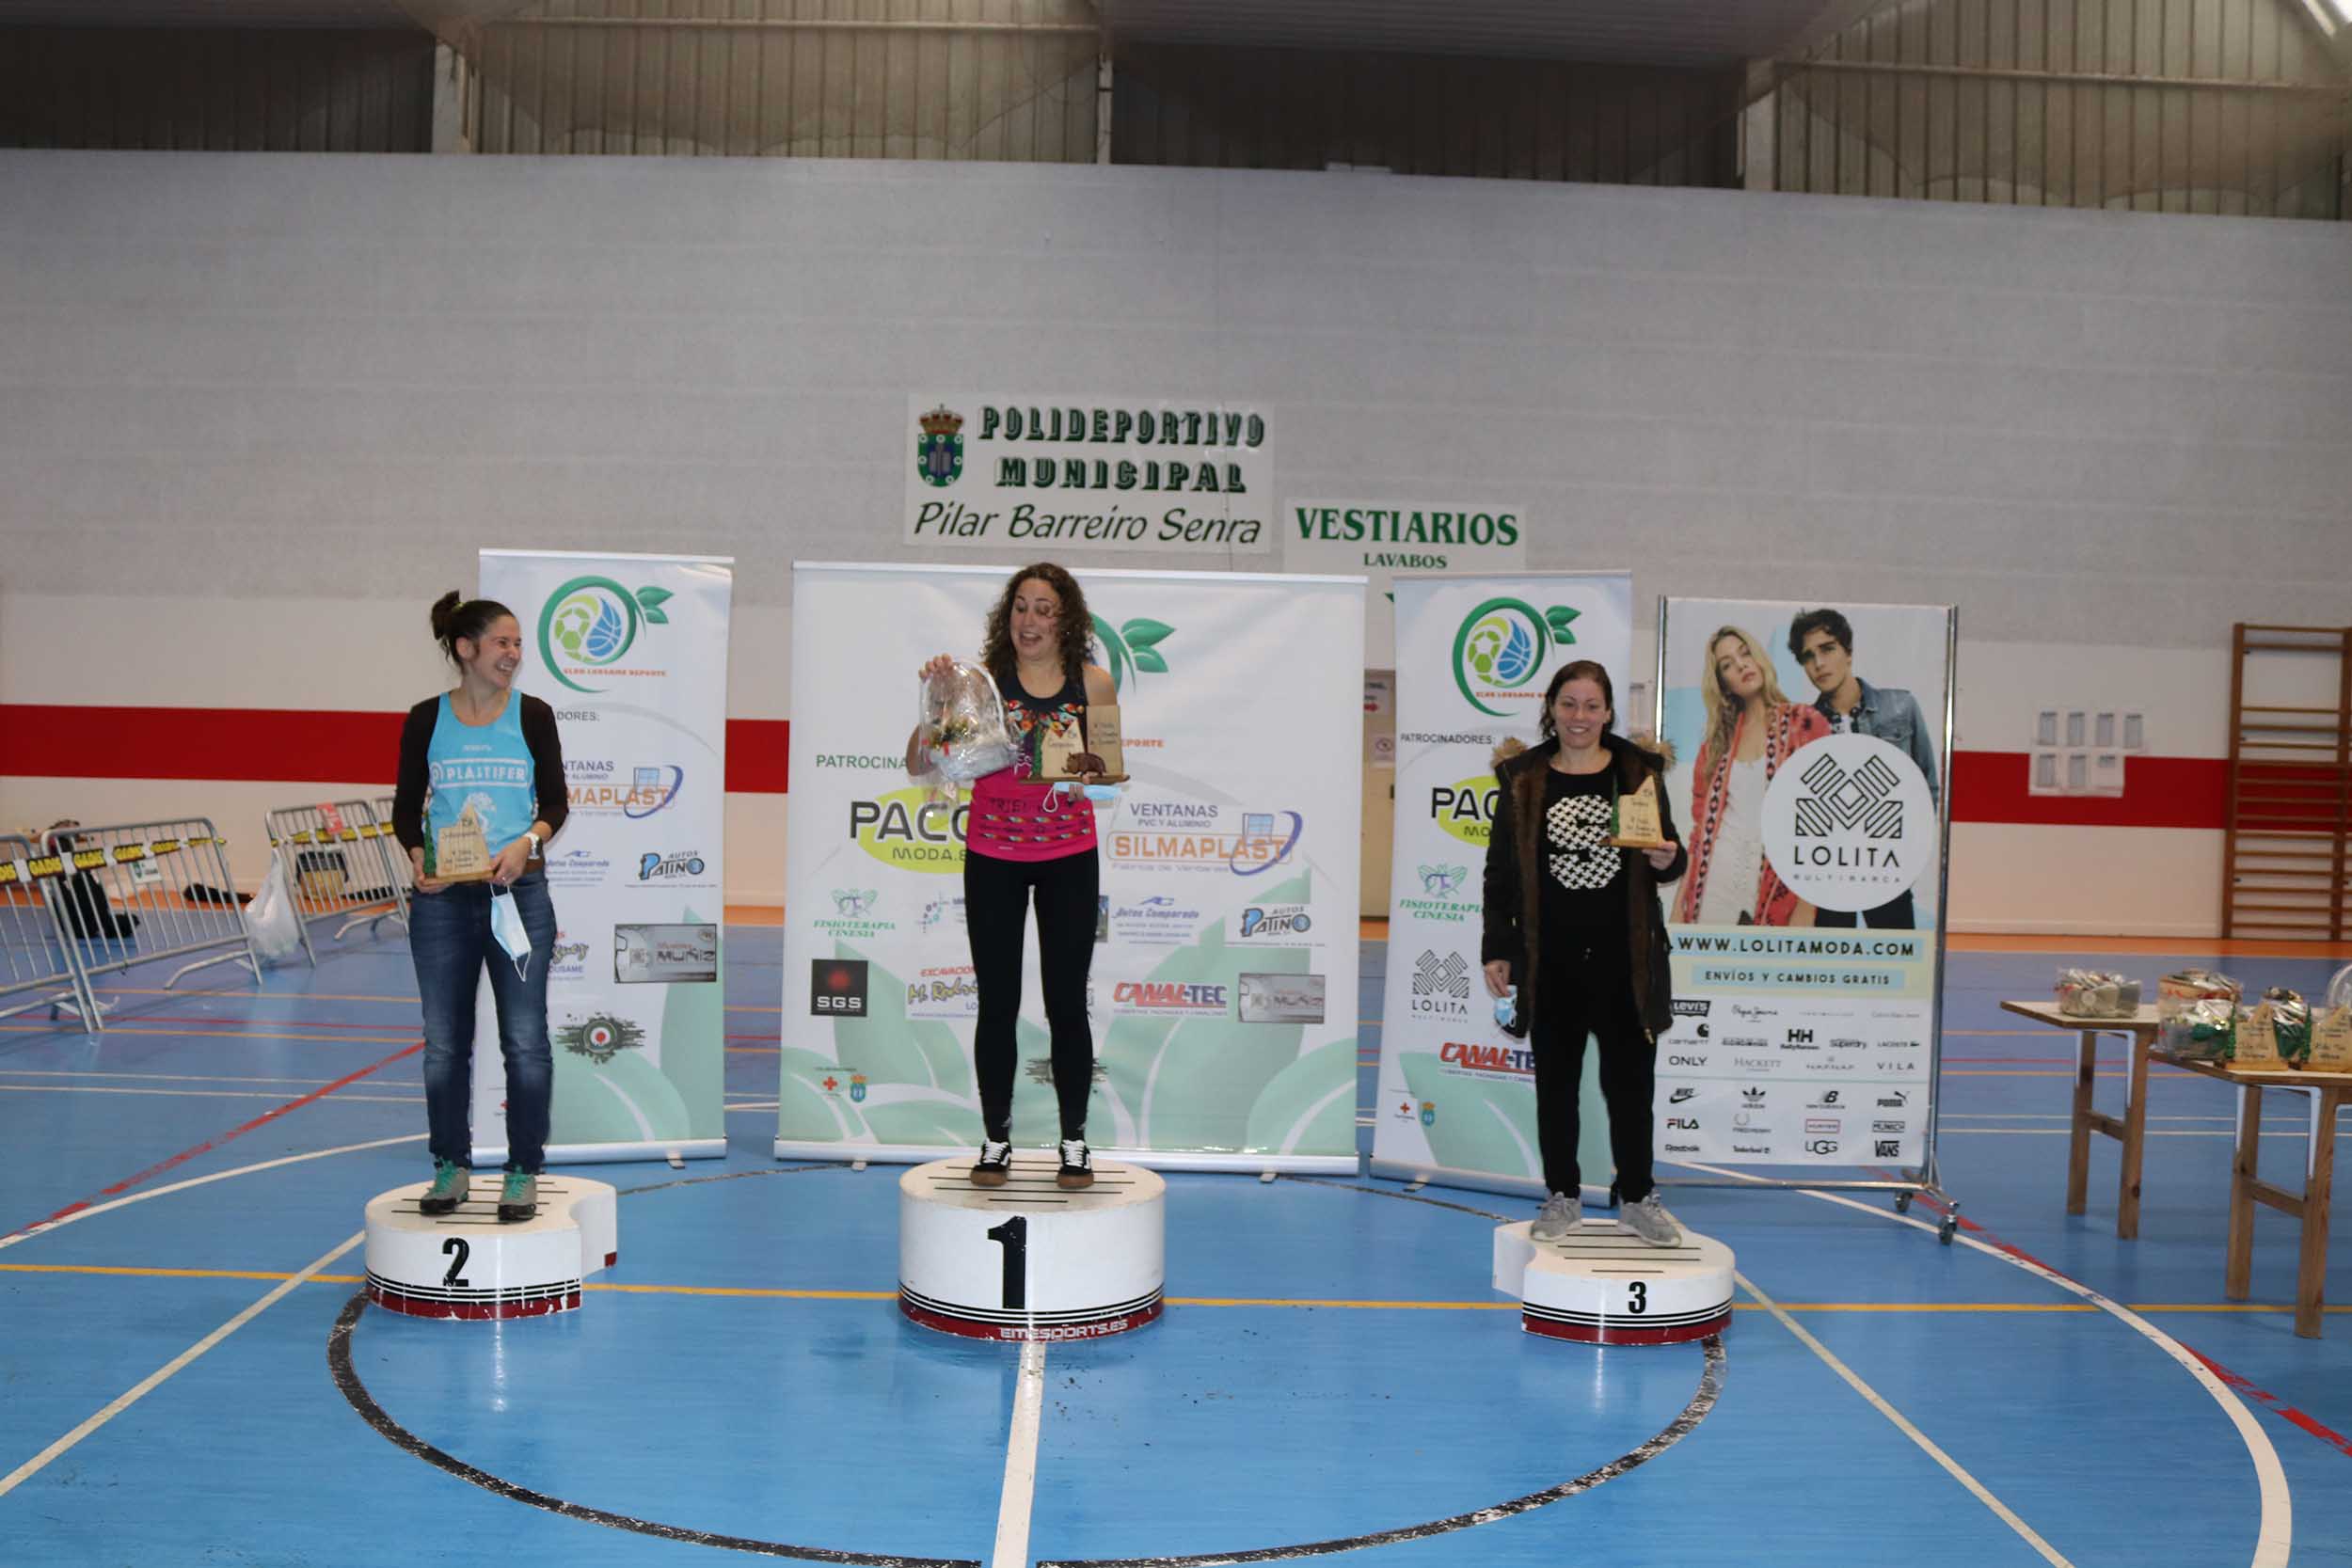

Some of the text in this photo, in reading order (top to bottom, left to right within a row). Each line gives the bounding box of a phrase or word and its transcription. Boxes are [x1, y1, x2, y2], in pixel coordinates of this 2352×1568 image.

[978, 405, 1265, 448] POLIDEPORTIVO
[995, 456, 1248, 493] MUNICIPAL
[914, 501, 1261, 544] Pilar Barreiro Senra
[1295, 507, 1518, 546] VESTIARIOS
[1363, 553, 1447, 570] LAVABOS
[1130, 803, 1219, 818] VENTANAS
[1137, 818, 1156, 828] PVC
[1158, 819, 1165, 828] Y
[1114, 835, 1288, 860] SILMAPLAST
[1793, 846, 1900, 868] LOLITA
[1677, 936, 1915, 957] WWW.LOLITAMODA.COM
[1762, 972, 1770, 982] Y
[1777, 973, 1836, 984] CAMBIOS
[1842, 974, 1890, 986] GRATIS
[817, 996, 862, 1009] SGS
[1411, 999, 1469, 1015] LOLITA
[1788, 1028, 1814, 1043] HH
[1669, 1055, 1708, 1067] ONLY
[1877, 1062, 1915, 1070] VILA
[1665, 1117, 1700, 1130] FILA
[1804, 1139, 1838, 1155] UGG
[1874, 1139, 1900, 1158] VANS
[442, 1238, 469, 1287] 2
[988, 1215, 1026, 1309] 1
[1628, 1281, 1646, 1314] 3
